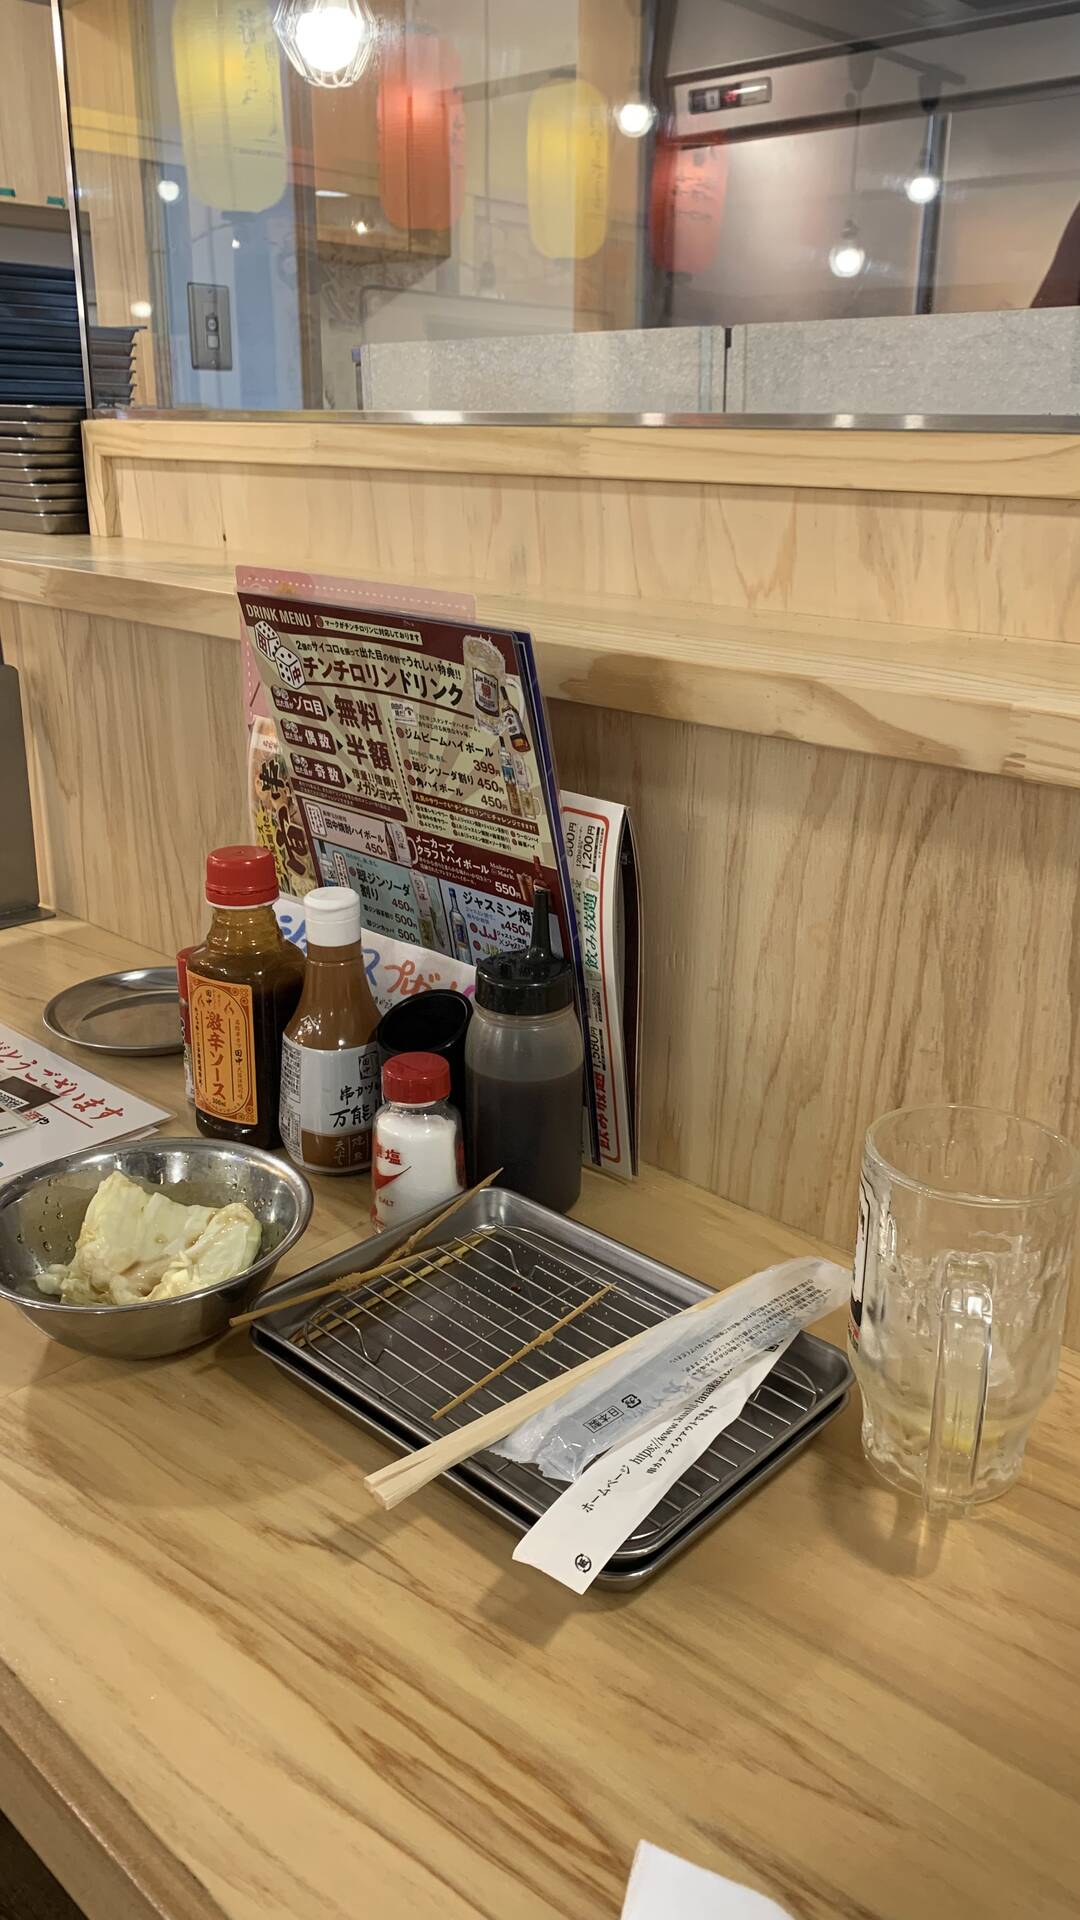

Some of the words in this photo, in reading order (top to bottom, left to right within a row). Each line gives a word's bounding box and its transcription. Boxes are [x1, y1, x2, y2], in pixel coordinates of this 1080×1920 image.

[245, 604, 279, 621] DRINK
[278, 609, 312, 627] MENU
[290, 665, 304, 683] 中
[300, 654, 466, 707] チンチロリンドリンク
[291, 694, 324, 716] ゾロ目
[331, 693, 385, 735] 無料
[303, 729, 331, 749] 偶数
[403, 728, 494, 758] ジムビームハイボール
[342, 732, 394, 772] 半額
[312, 762, 340, 782] 奇数
[471, 759, 501, 776] 399円
[354, 780, 403, 805] メガジョッキ
[415, 776, 464, 796] 角ハイボール
[475, 777, 504, 794] 450円
[479, 794, 508, 811] 450円
[364, 842, 387, 856] 450円
[413, 833, 456, 854] メーカーズ
[582, 825, 595, 870] 1,200円
[416, 845, 490, 875] クラフトハイボール
[358, 883, 379, 901] 割り
[493, 881, 521, 899] 550円
[390, 897, 414, 913] 450円
[461, 888, 537, 927] ジャスミン焼
[393, 912, 418, 929] 500円
[583, 891, 598, 970] 飲み放題
[206, 1011, 225, 1100] 激辛ソース
[329, 1103, 376, 1128] 万能
[589, 1408, 619, 1429] 日本製
[582, 1464, 631, 1513] ホームページ
